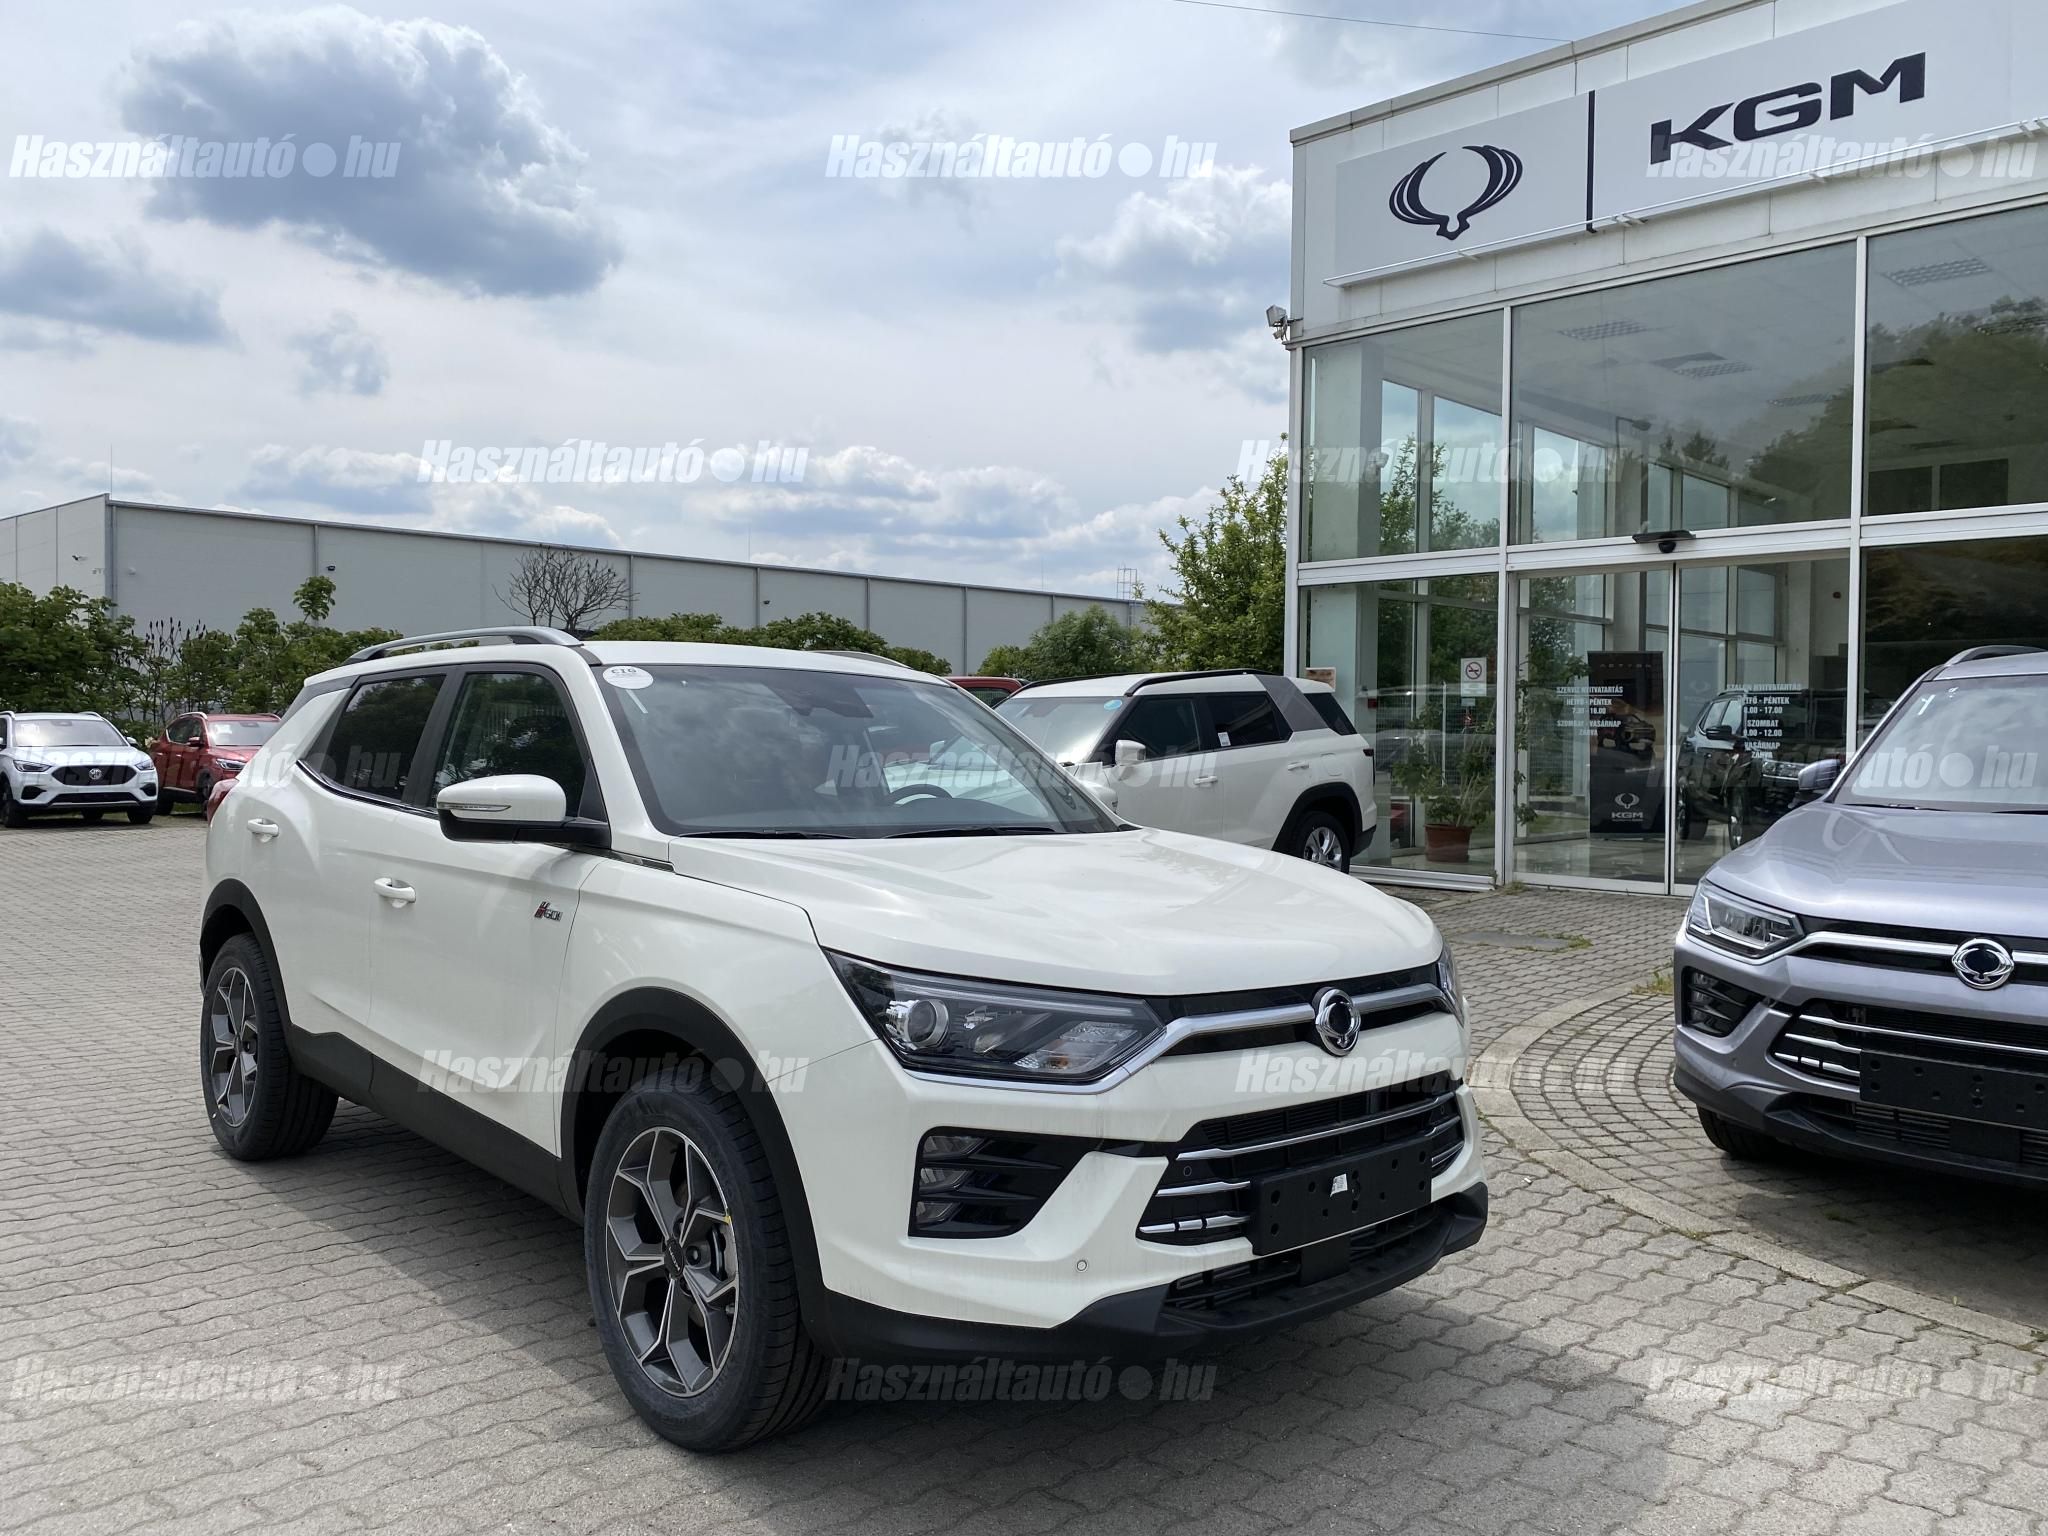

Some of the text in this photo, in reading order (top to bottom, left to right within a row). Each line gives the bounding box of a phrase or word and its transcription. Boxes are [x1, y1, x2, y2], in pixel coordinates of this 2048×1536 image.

[1650, 51, 1926, 165] KGM
[1763, 696, 1790, 705] PÉNTEK
[1747, 719, 1779, 728] SZOMBAT
[1744, 740, 1781, 750] VASÁRNAP
[1611, 811, 1644, 819] KGM
